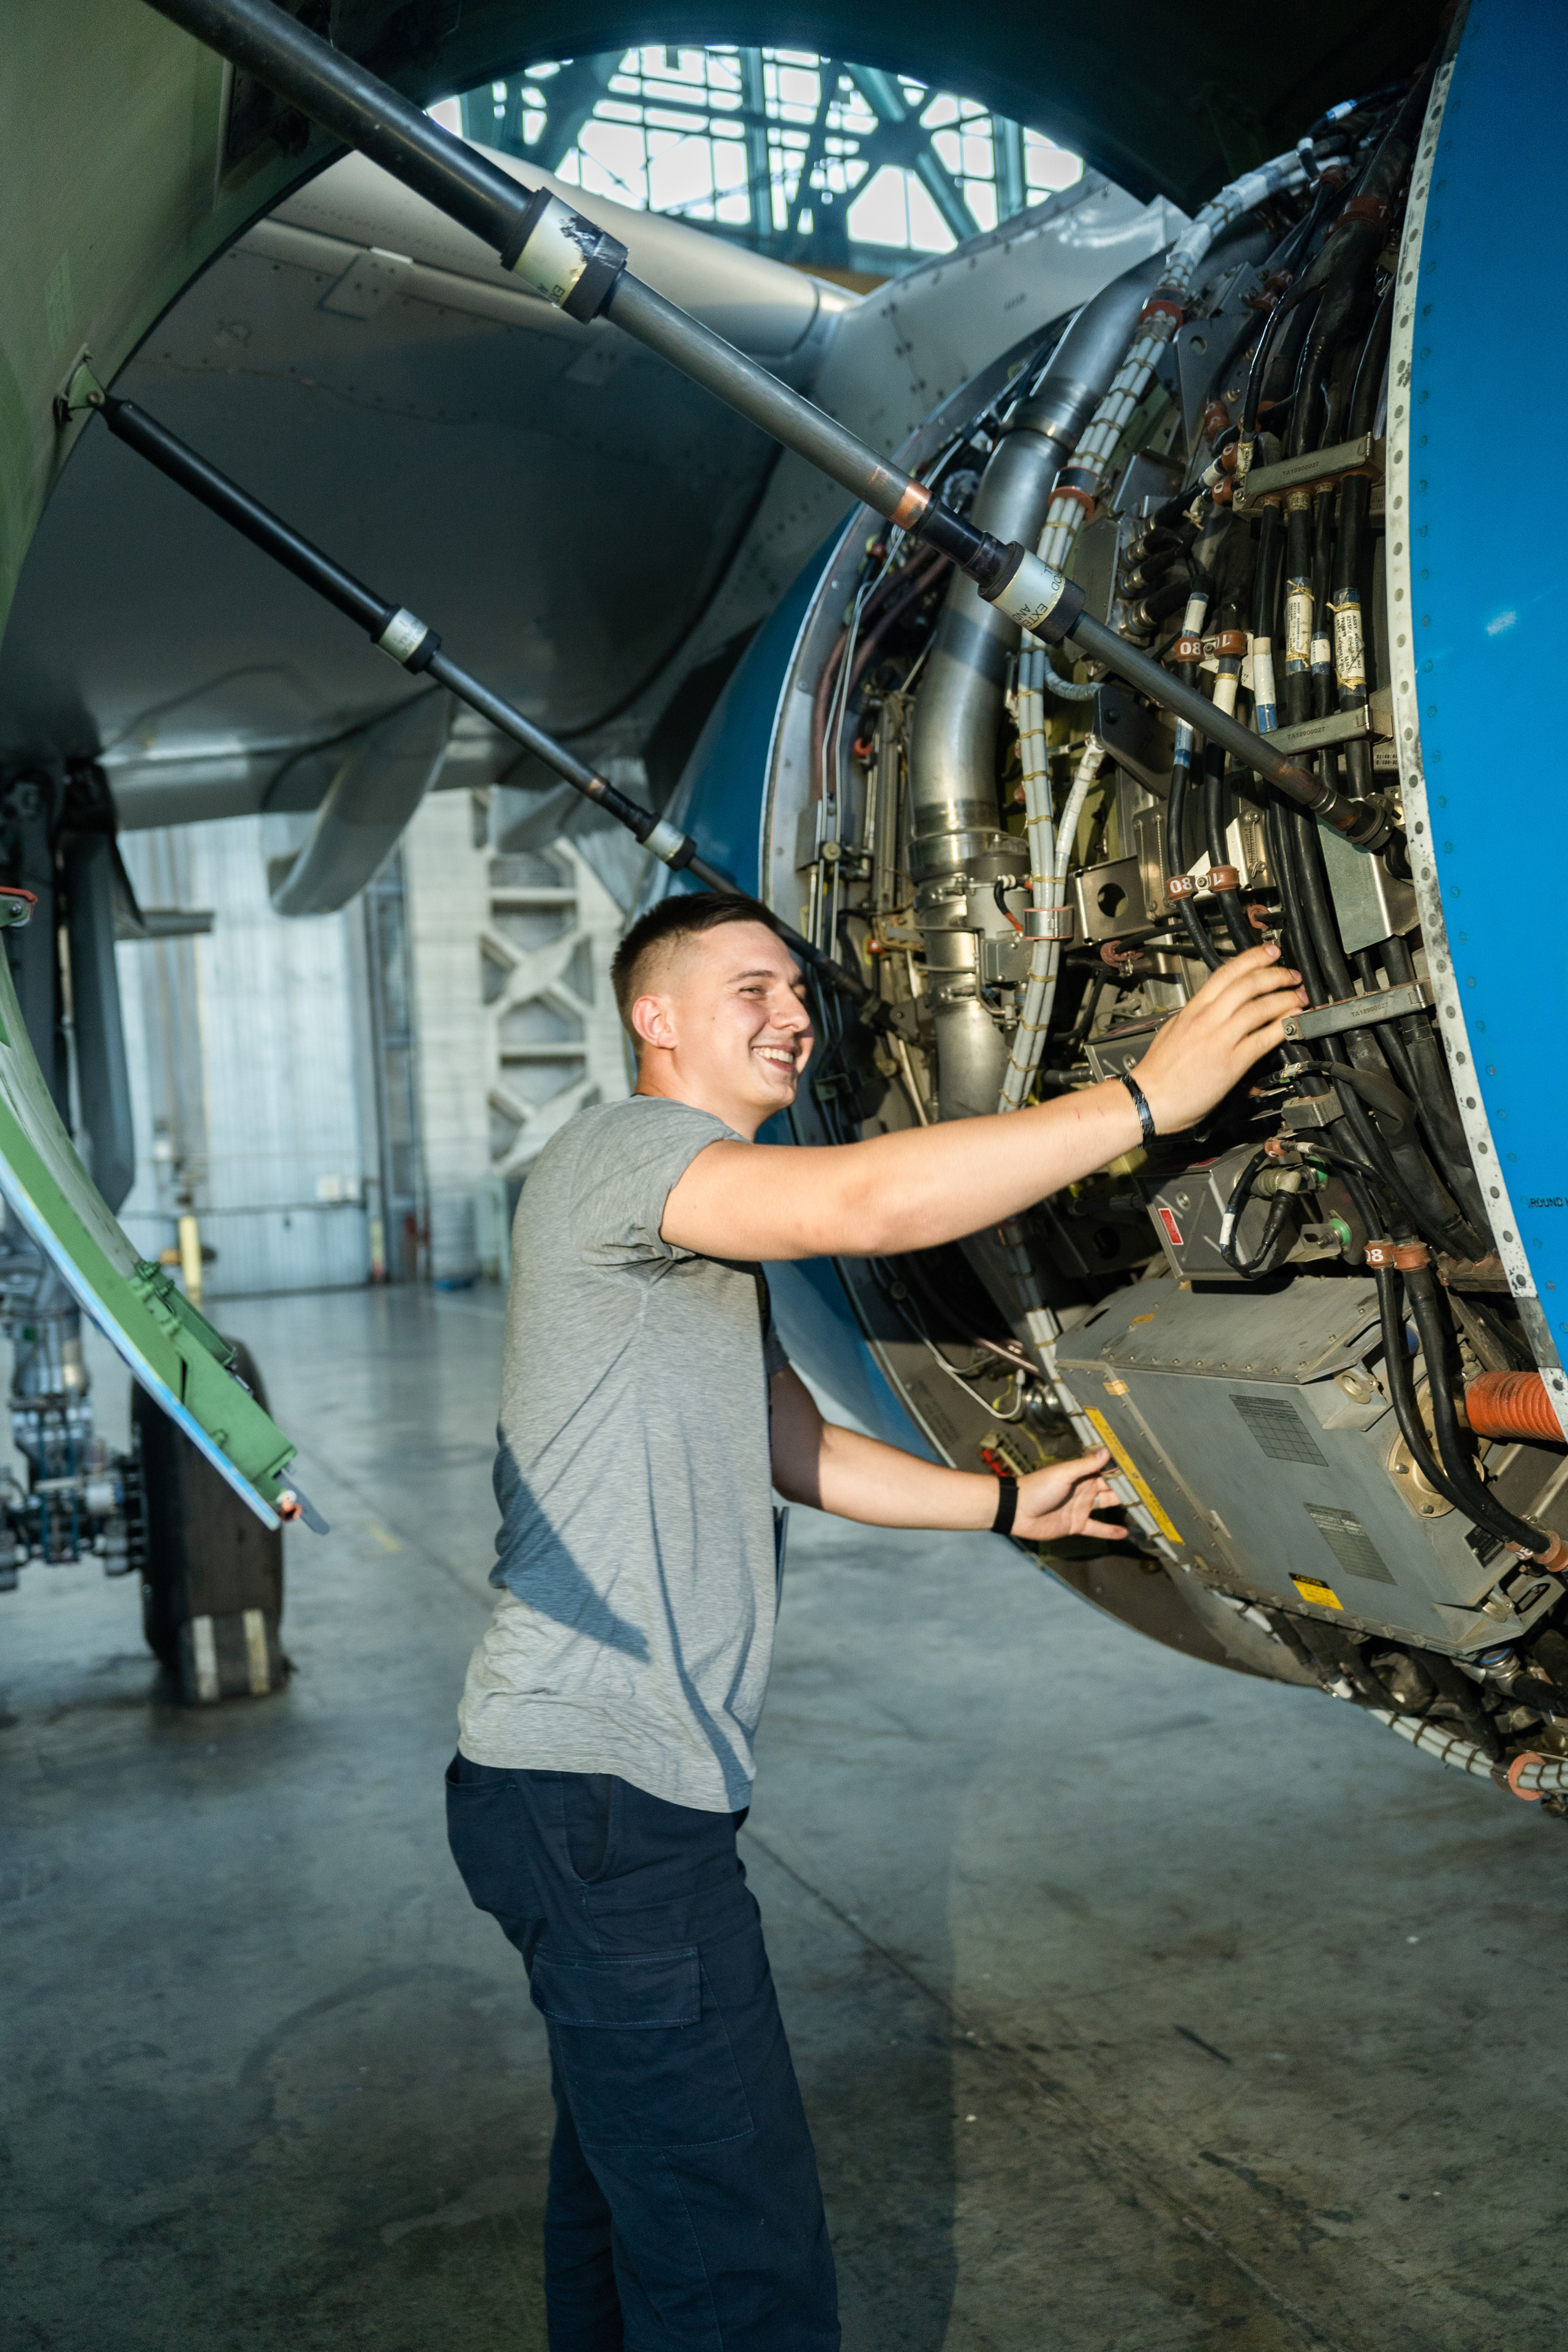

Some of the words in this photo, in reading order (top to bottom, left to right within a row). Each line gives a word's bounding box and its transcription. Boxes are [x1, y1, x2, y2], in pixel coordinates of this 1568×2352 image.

[1012, 603, 1031, 622] AND
[1287, 726, 1325, 739] TA18900027
[1351, 1002, 1388, 1017] TA18900027
